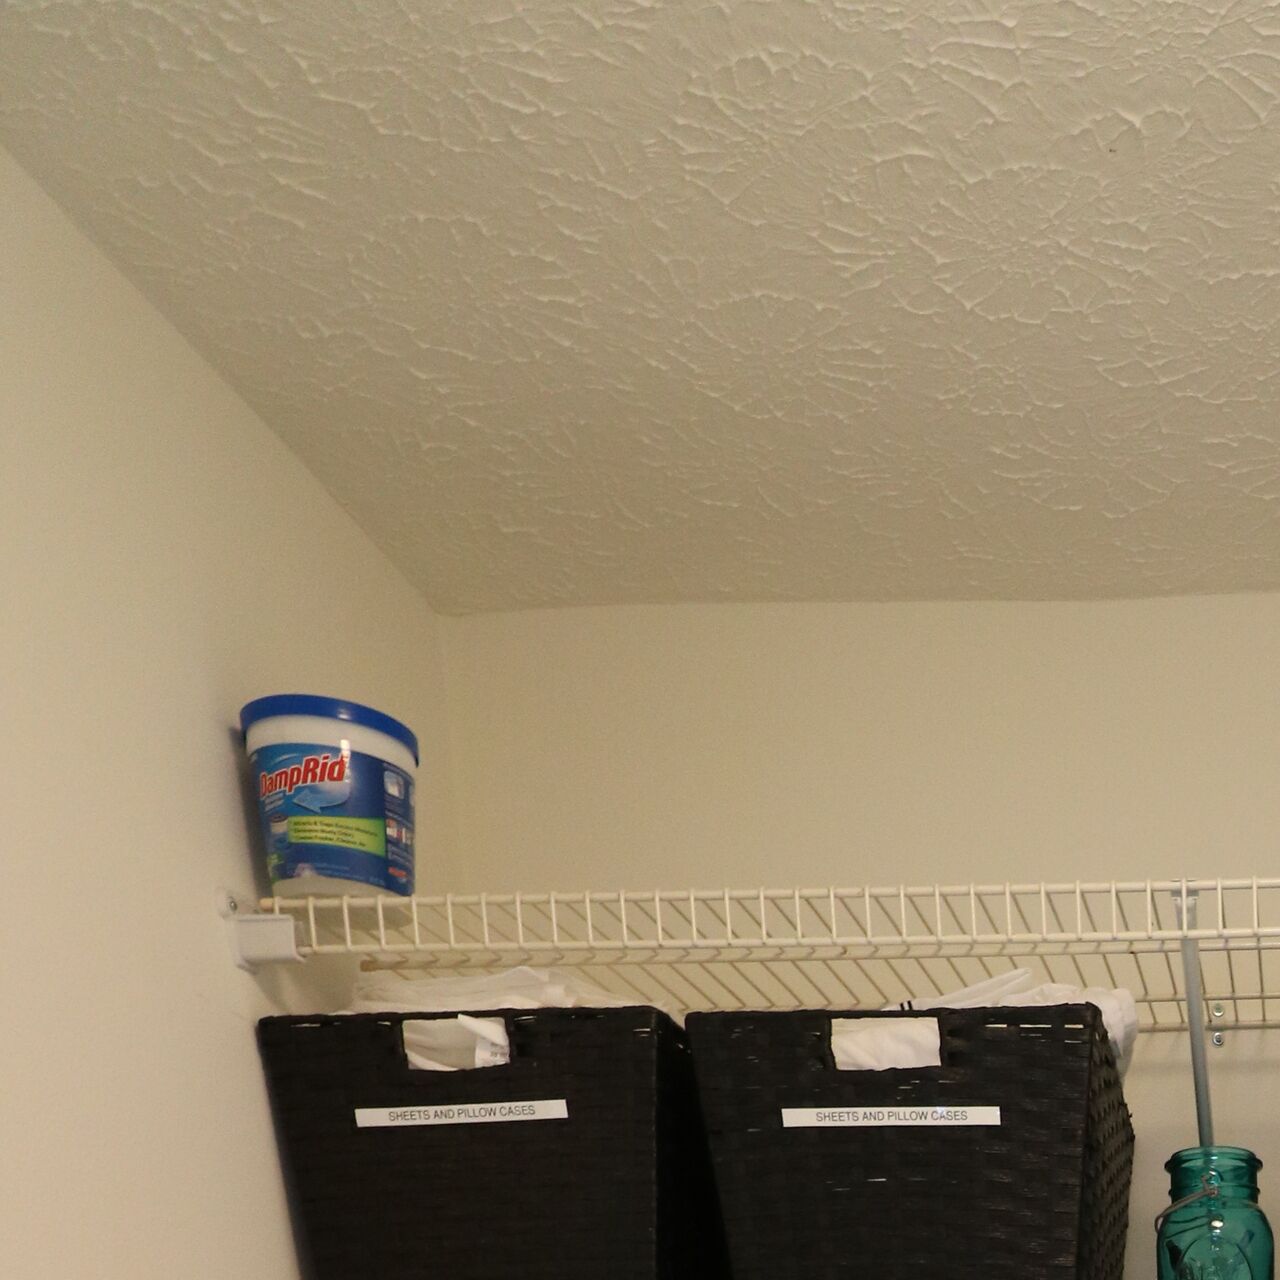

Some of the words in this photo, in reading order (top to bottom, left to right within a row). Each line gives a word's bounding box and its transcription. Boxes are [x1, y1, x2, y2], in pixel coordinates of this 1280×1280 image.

[260, 753, 347, 797] DampRid
[388, 1110, 431, 1122] SHEETS
[433, 1109, 455, 1120] AND
[457, 1107, 497, 1120] PILLOW
[499, 1105, 536, 1117] CASES
[816, 1111, 859, 1122] SHEETS
[862, 1111, 885, 1121] AND
[887, 1111, 928, 1121] PILLOW
[931, 1110, 968, 1121] CASES
